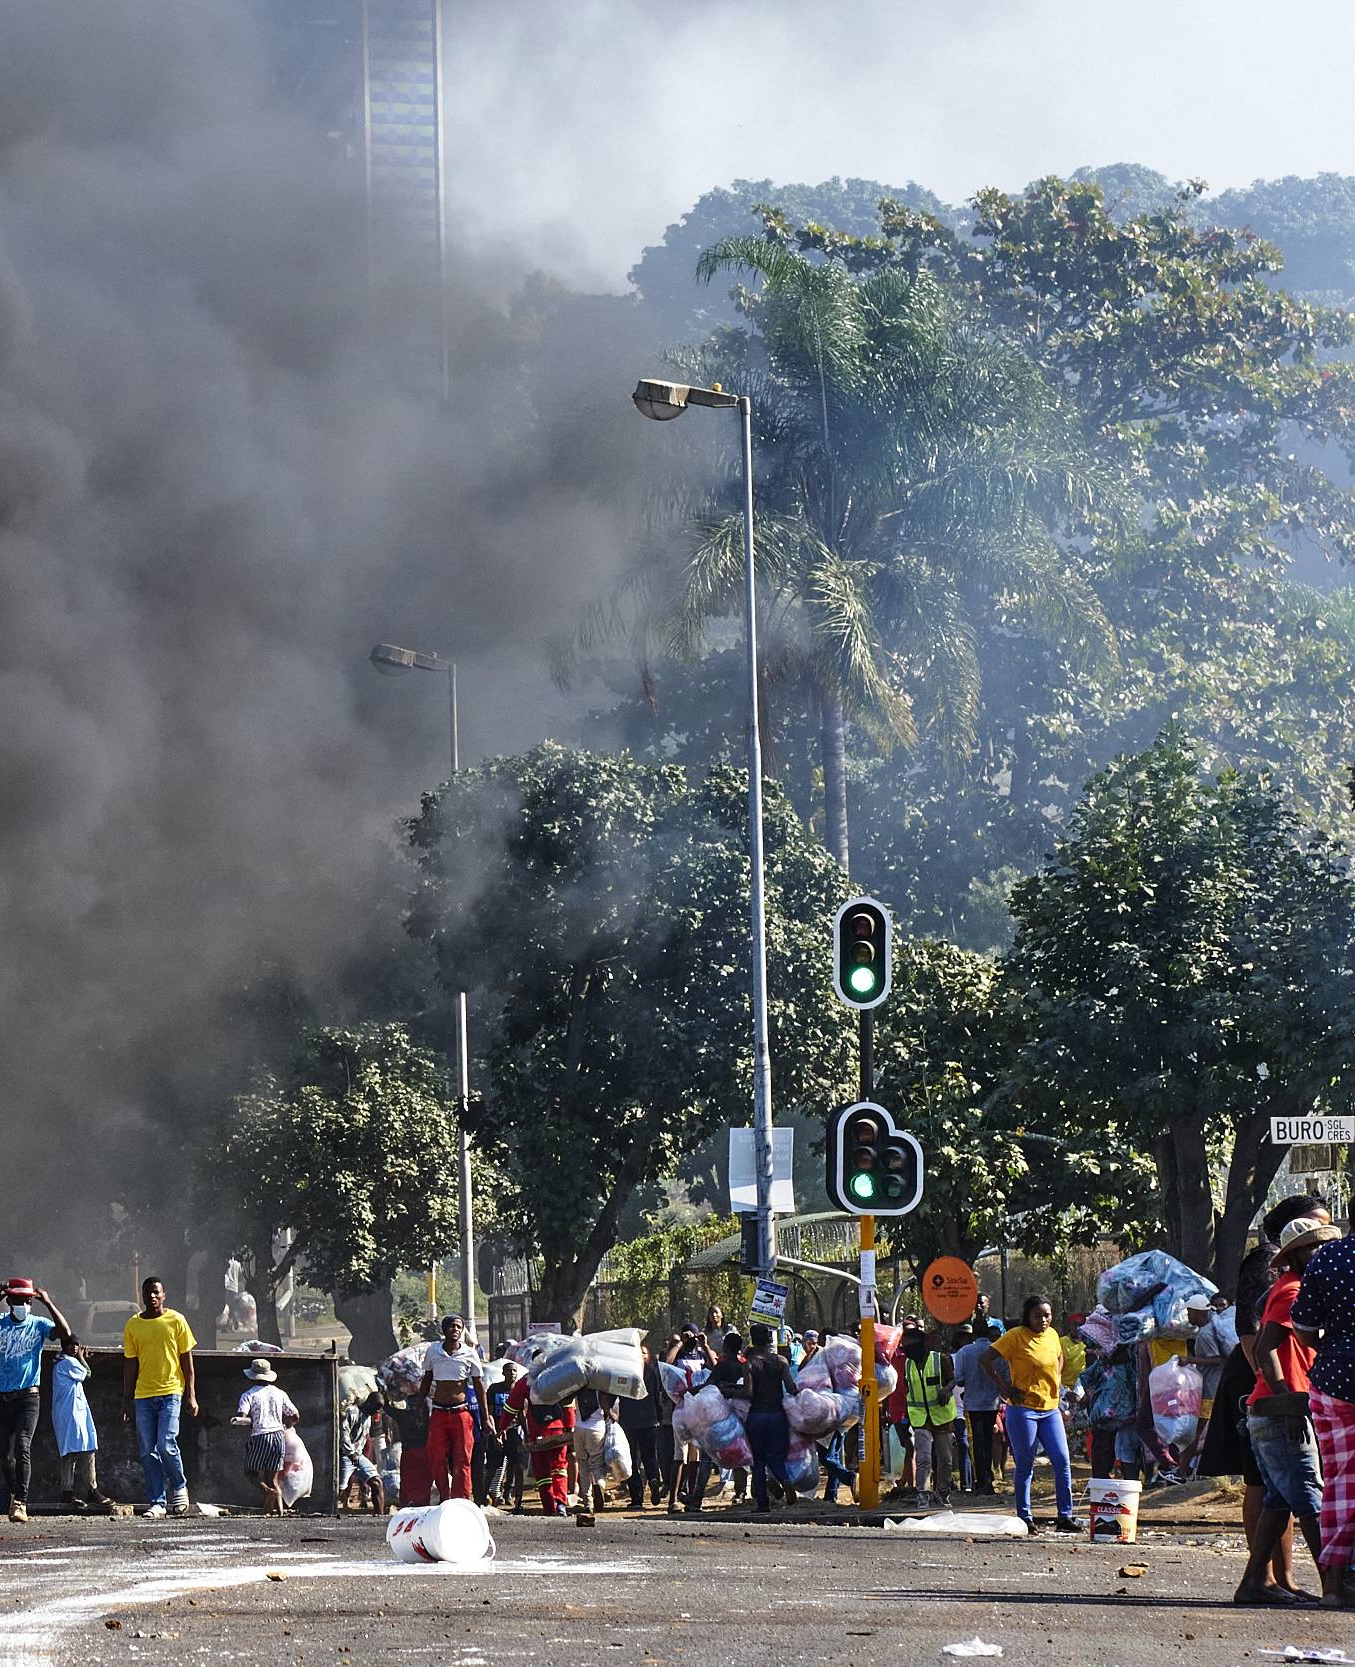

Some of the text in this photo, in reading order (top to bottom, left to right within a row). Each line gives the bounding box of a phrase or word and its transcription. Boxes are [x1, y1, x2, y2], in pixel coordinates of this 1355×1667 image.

[1277, 1120, 1346, 1140] BURO SGL
[1327, 1130, 1351, 1141] CRES
[1097, 1506, 1123, 1514] CLASSIC
